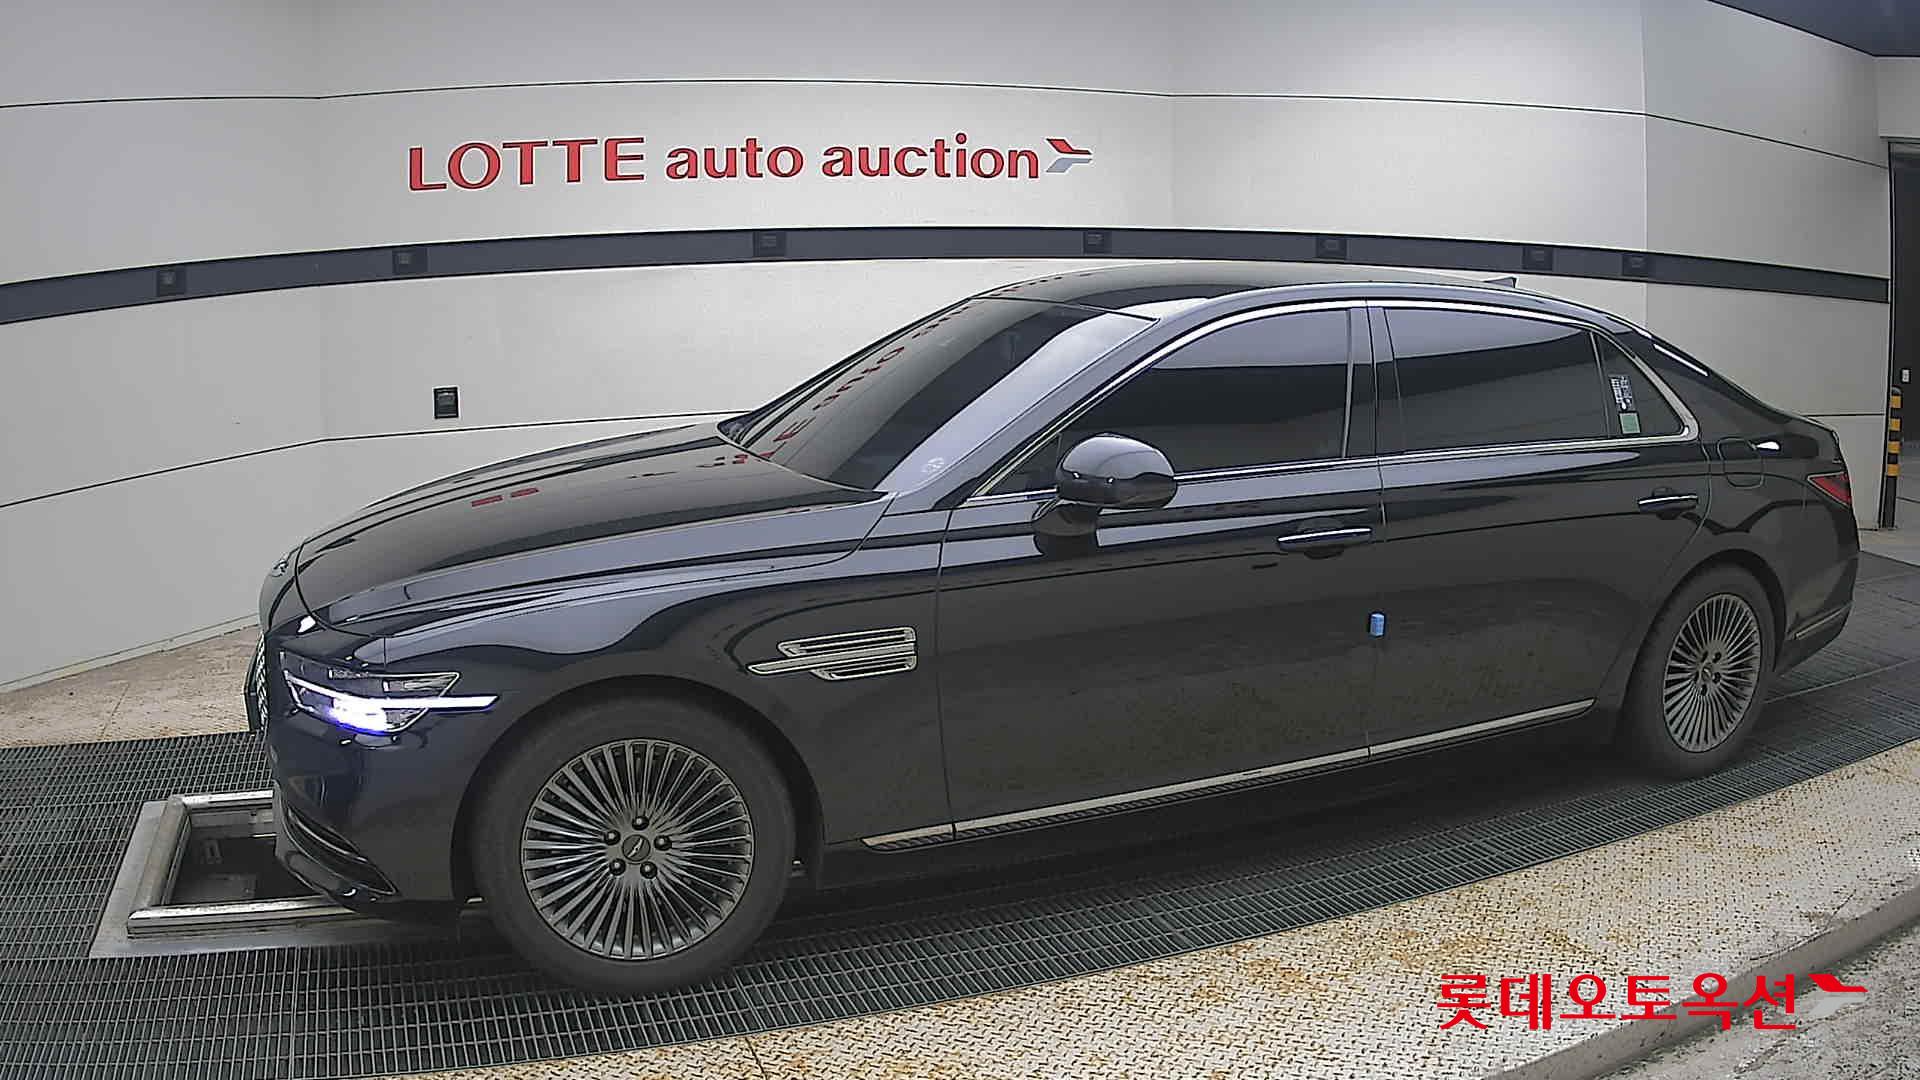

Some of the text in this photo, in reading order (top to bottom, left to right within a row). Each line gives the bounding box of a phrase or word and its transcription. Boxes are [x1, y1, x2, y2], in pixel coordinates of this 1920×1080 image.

[409, 133, 1040, 191] LOTTE auto auction
